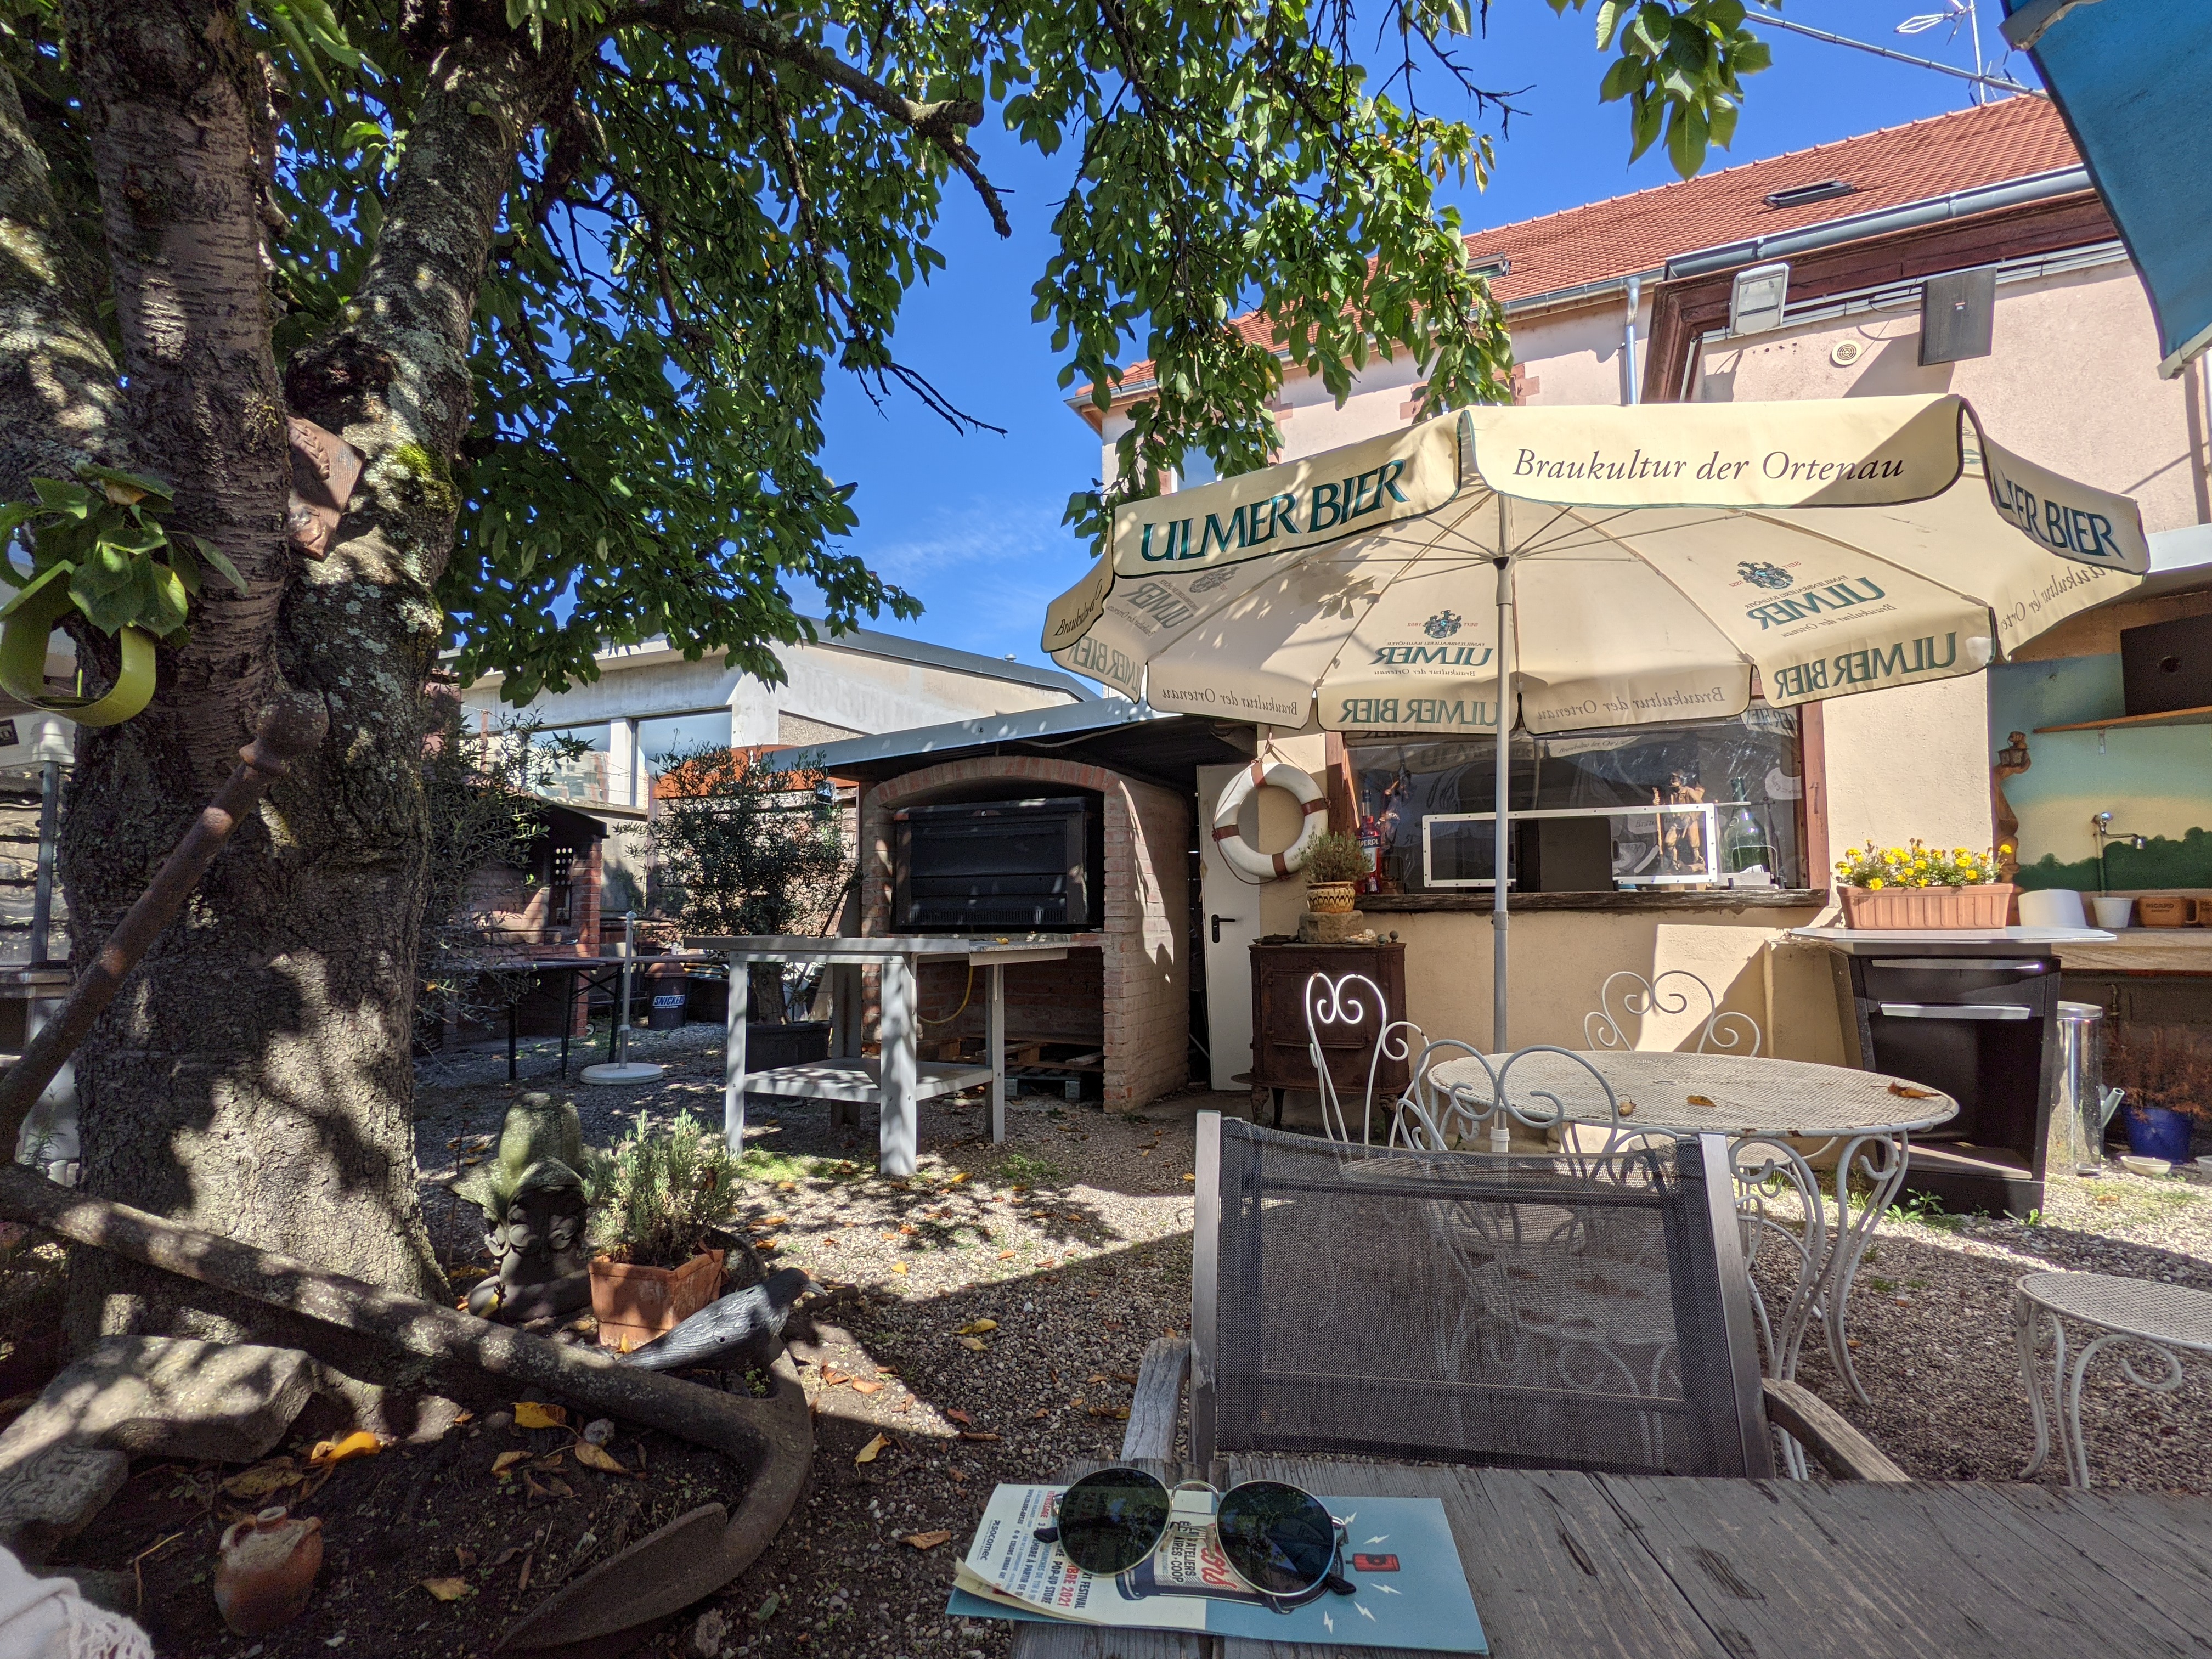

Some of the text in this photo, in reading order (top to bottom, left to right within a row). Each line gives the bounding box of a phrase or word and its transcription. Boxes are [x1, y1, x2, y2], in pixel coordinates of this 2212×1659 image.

[1512, 448, 1904, 481] Braukultur der Ortenau
[1141, 459, 1411, 561] ULMER BIER
[2044, 499, 2125, 560] BIER
[980, 1526, 998, 1561] socomec
[1047, 1561, 1063, 1584] POP-UP
[1171, 1560, 1184, 1583] COOP
[1184, 1542, 1197, 1576] ATELIERS
[1019, 1564, 1034, 1583] PARTIR
[1041, 1585, 1056, 1604] STORE
[1057, 1586, 1074, 1607] 2021
[1074, 1581, 1091, 1609] FESTIVAL
